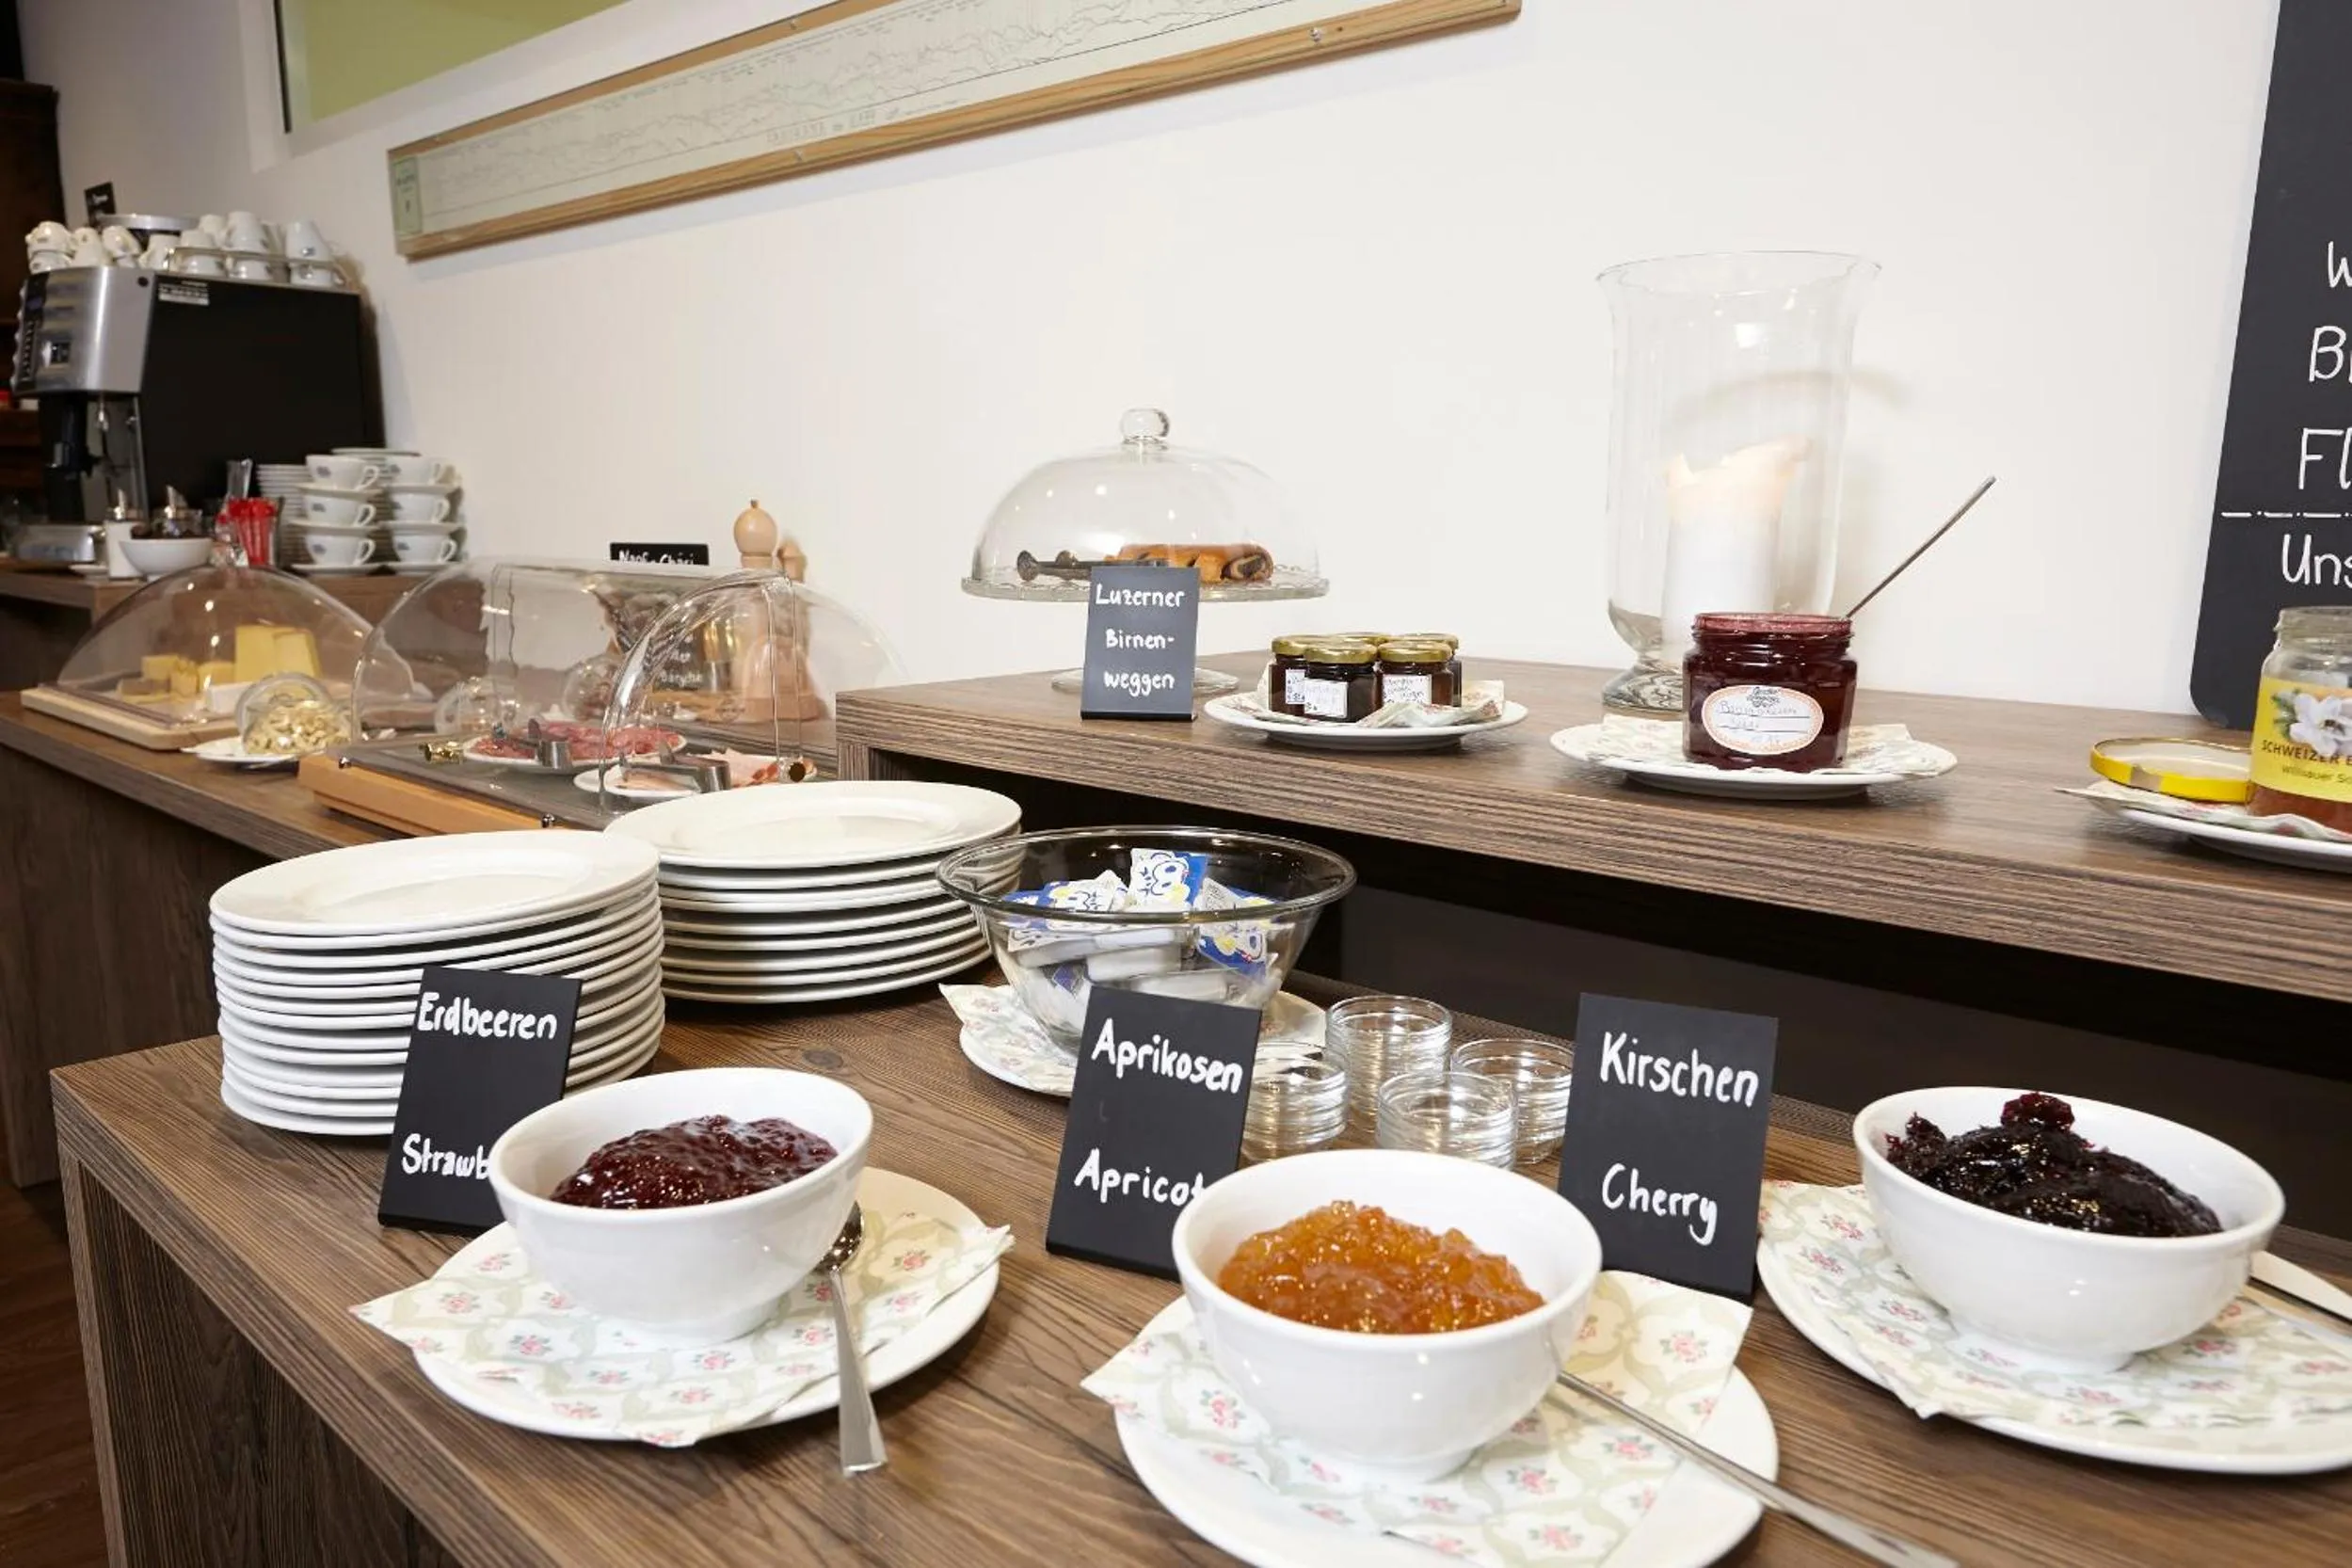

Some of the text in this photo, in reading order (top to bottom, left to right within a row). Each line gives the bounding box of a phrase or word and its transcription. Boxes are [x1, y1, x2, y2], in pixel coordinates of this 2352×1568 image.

[2309, 325, 2352, 383] B
[1095, 583, 1185, 608] Luzerner
[1105, 628, 1176, 650] Birnen-
[1103, 670, 1176, 697] weggen
[2261, 739, 2341, 764] SCHWEIZER
[417, 991, 558, 1040] Erdbeeren
[1091, 1017, 1243, 1094] Aprikosen
[1600, 1031, 1759, 1108] Kirschen
[401, 1132, 489, 1179] Strawb
[1074, 1147, 1205, 1207] Apricot
[1601, 1162, 1718, 1246] Cherry
